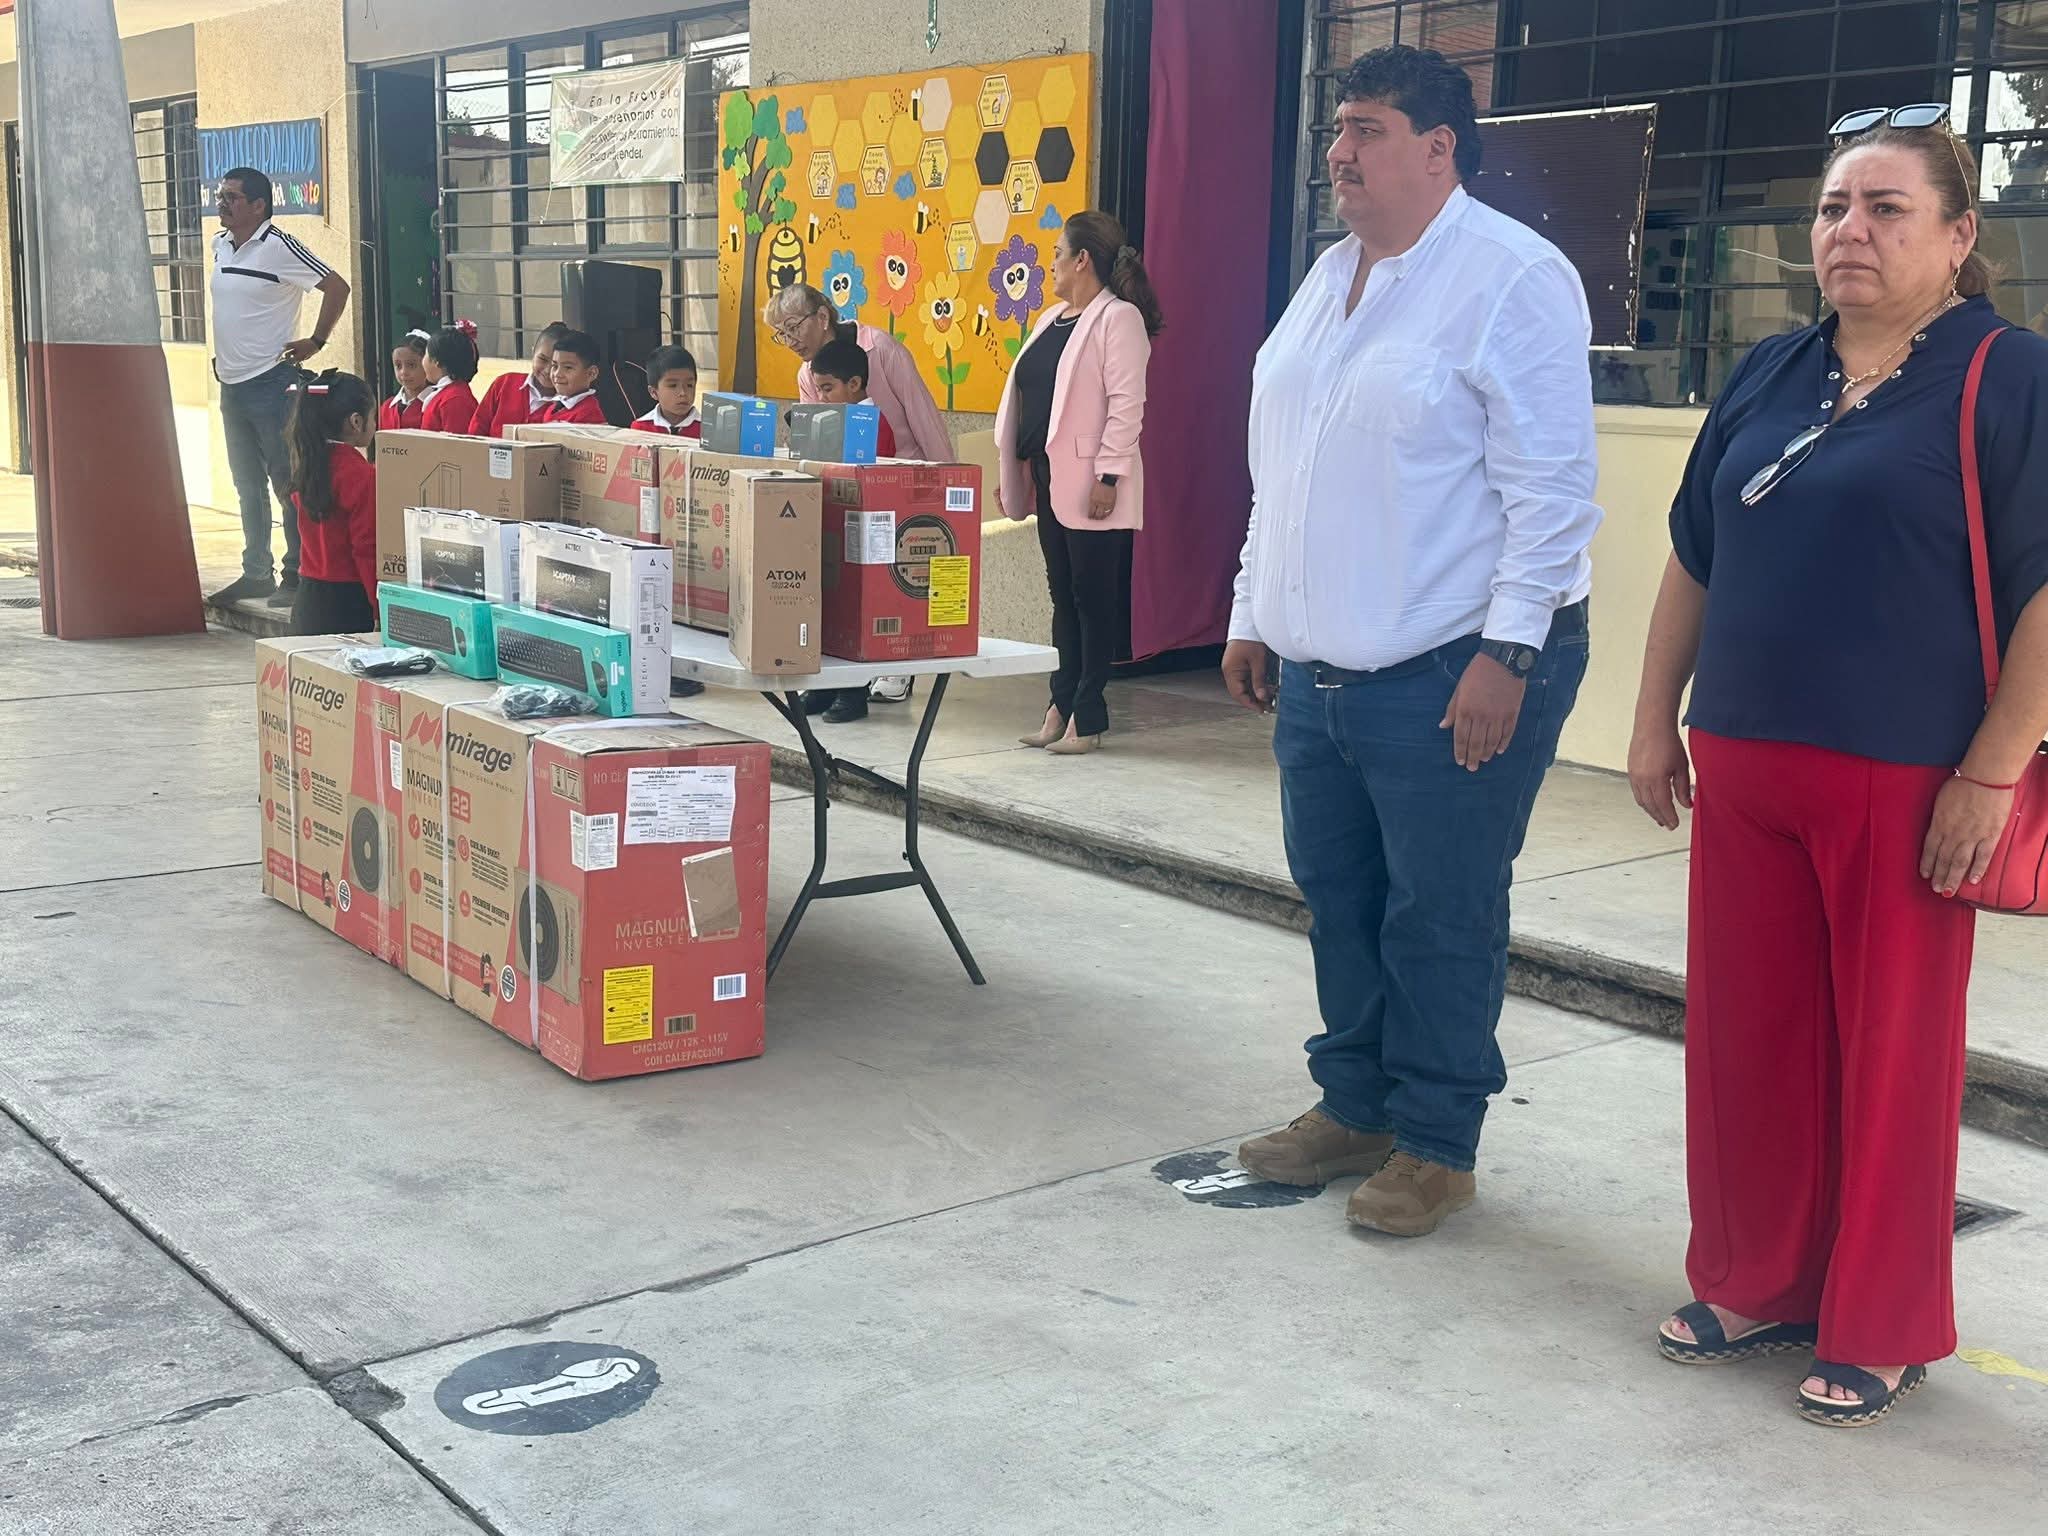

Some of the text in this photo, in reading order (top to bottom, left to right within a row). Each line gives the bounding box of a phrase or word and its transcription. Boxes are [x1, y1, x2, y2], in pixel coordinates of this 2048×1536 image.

[691, 463, 730, 487] mirag
[383, 562, 407, 574] ATO
[766, 570, 806, 581] ATOM
[783, 581, 801, 590] 240
[291, 676, 345, 712] mirage
[295, 728, 312, 753] 22
[446, 731, 513, 773] mirage
[451, 792, 471, 819] 22
[644, 1055, 663, 1067] CON
